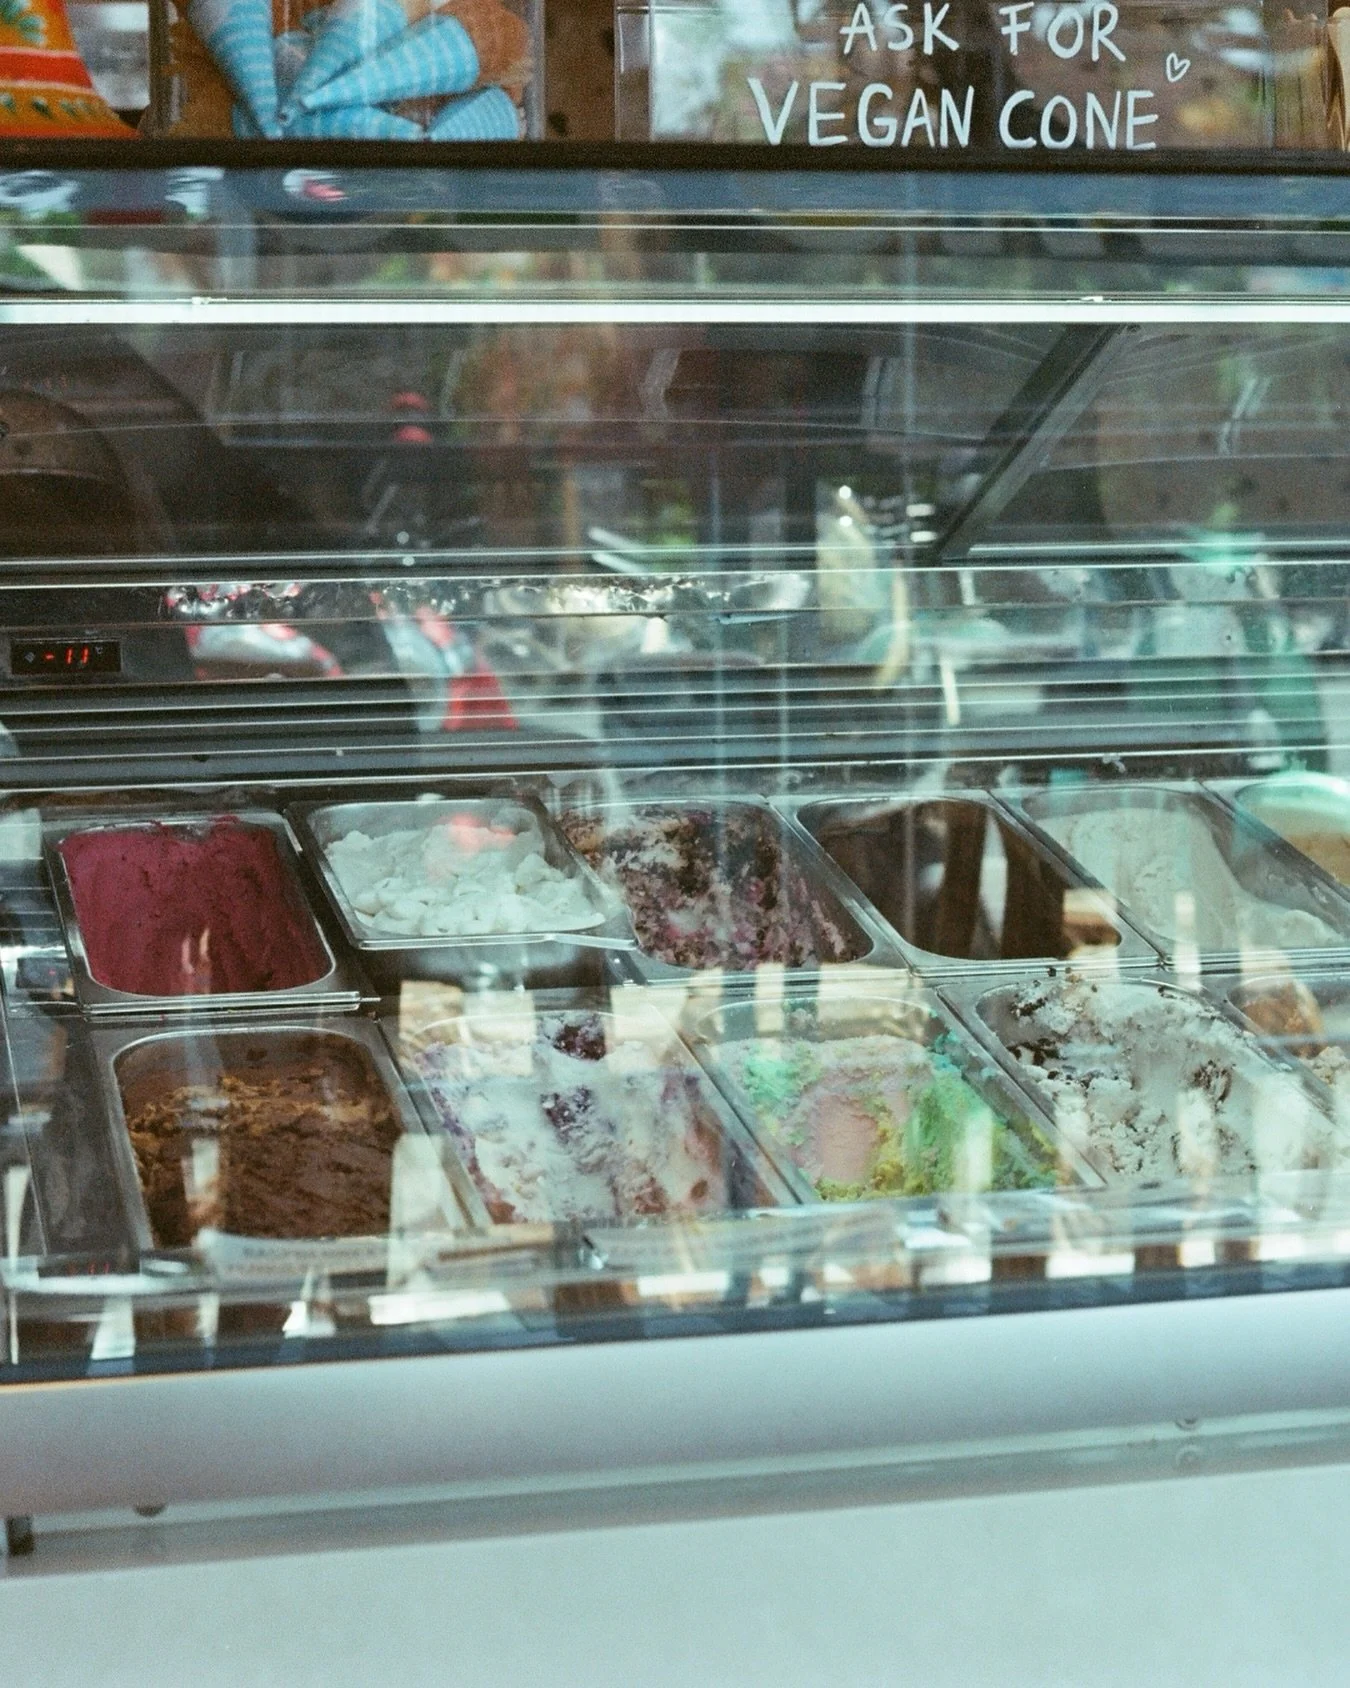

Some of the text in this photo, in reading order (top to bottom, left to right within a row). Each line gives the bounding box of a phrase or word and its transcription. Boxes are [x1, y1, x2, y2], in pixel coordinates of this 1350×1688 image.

[839, 1, 1126, 62] ASK FOR
[748, 76, 1159, 151] VEGAN CONE
[44, 646, 90, 665] -11
